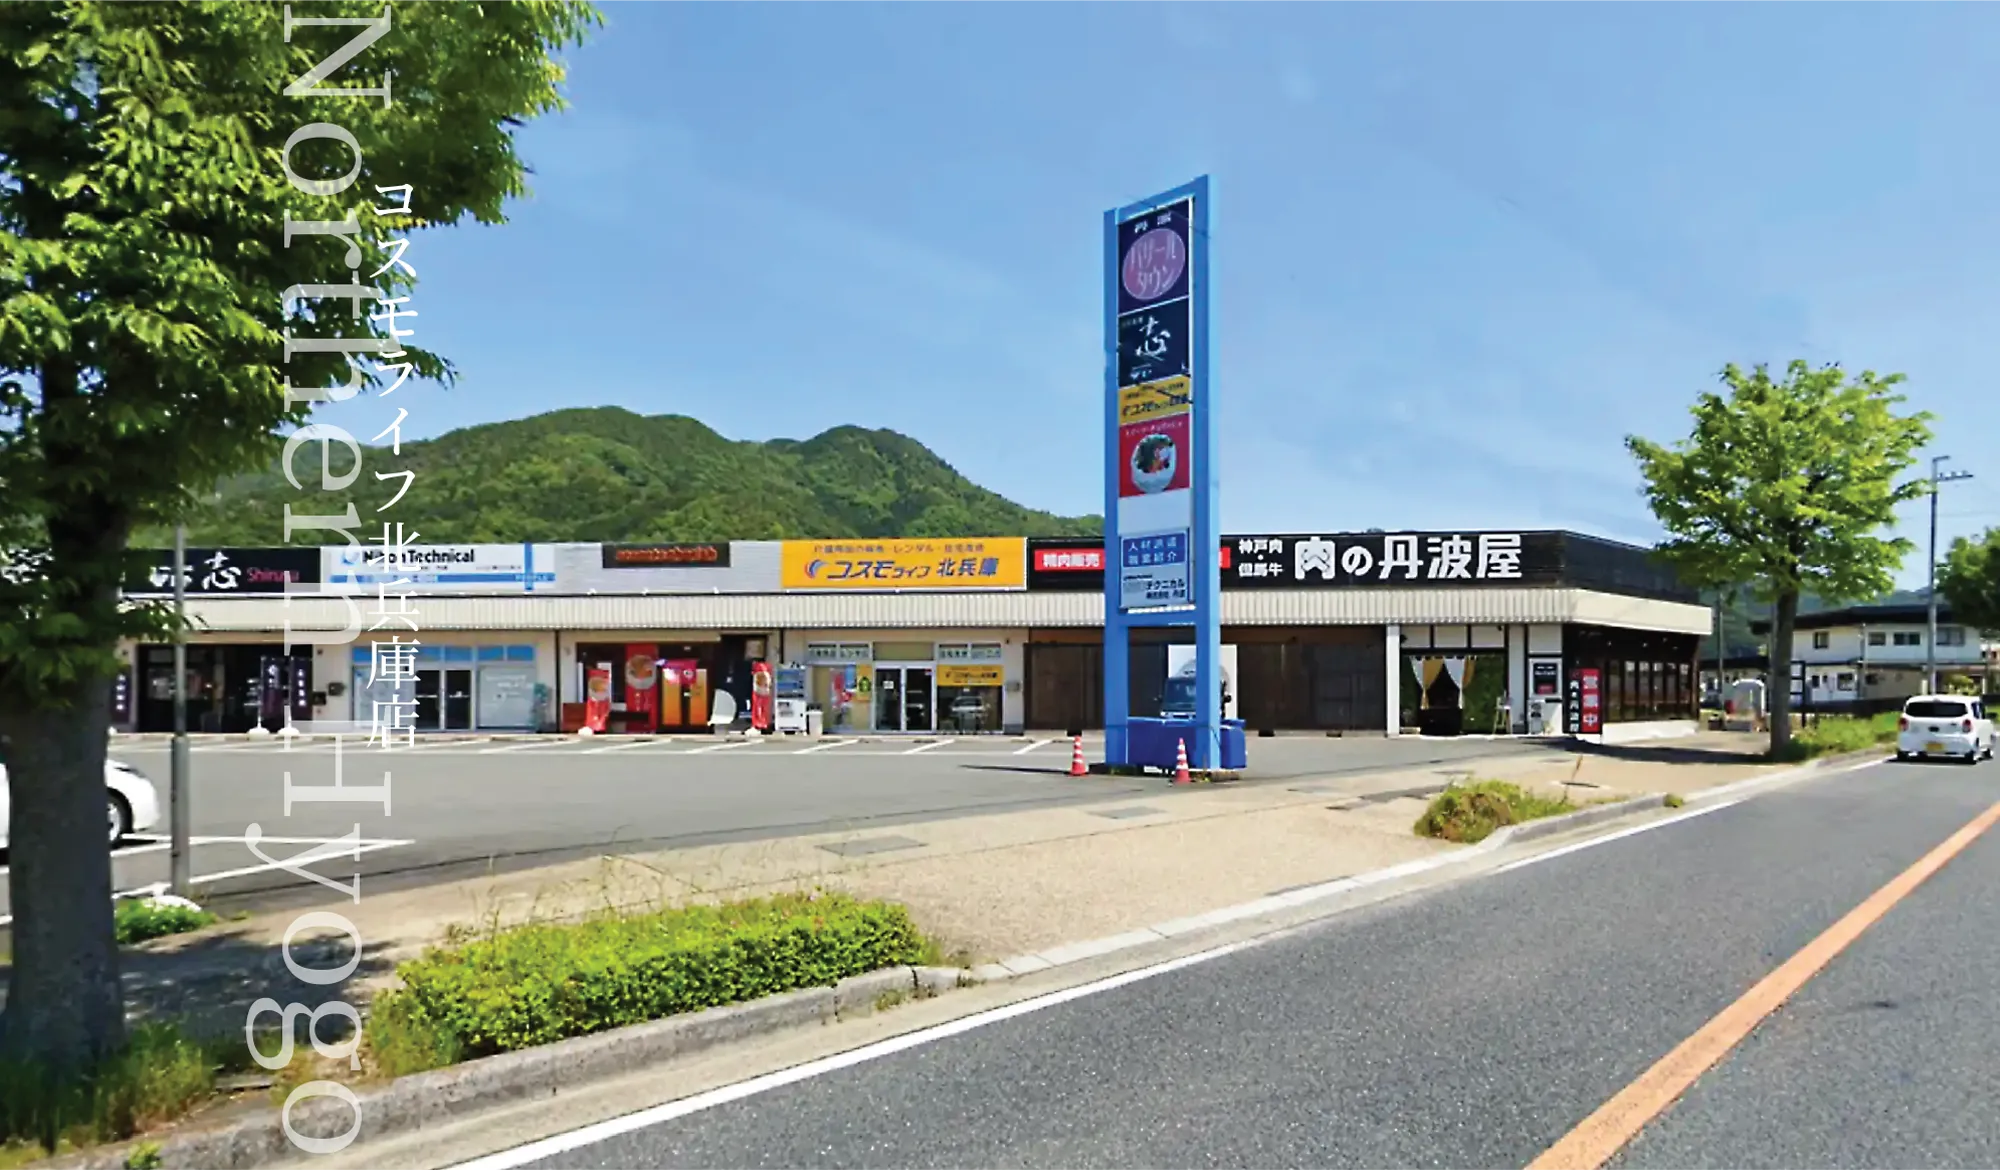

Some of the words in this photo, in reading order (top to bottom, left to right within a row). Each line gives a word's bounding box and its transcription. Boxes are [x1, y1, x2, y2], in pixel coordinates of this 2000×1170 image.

[1238, 539, 1283, 554] 神戸肉
[408, 549, 475, 563] Technical
[1294, 535, 1522, 580] 肉の丹波屋
[1238, 562, 1283, 577] 但馬牛
